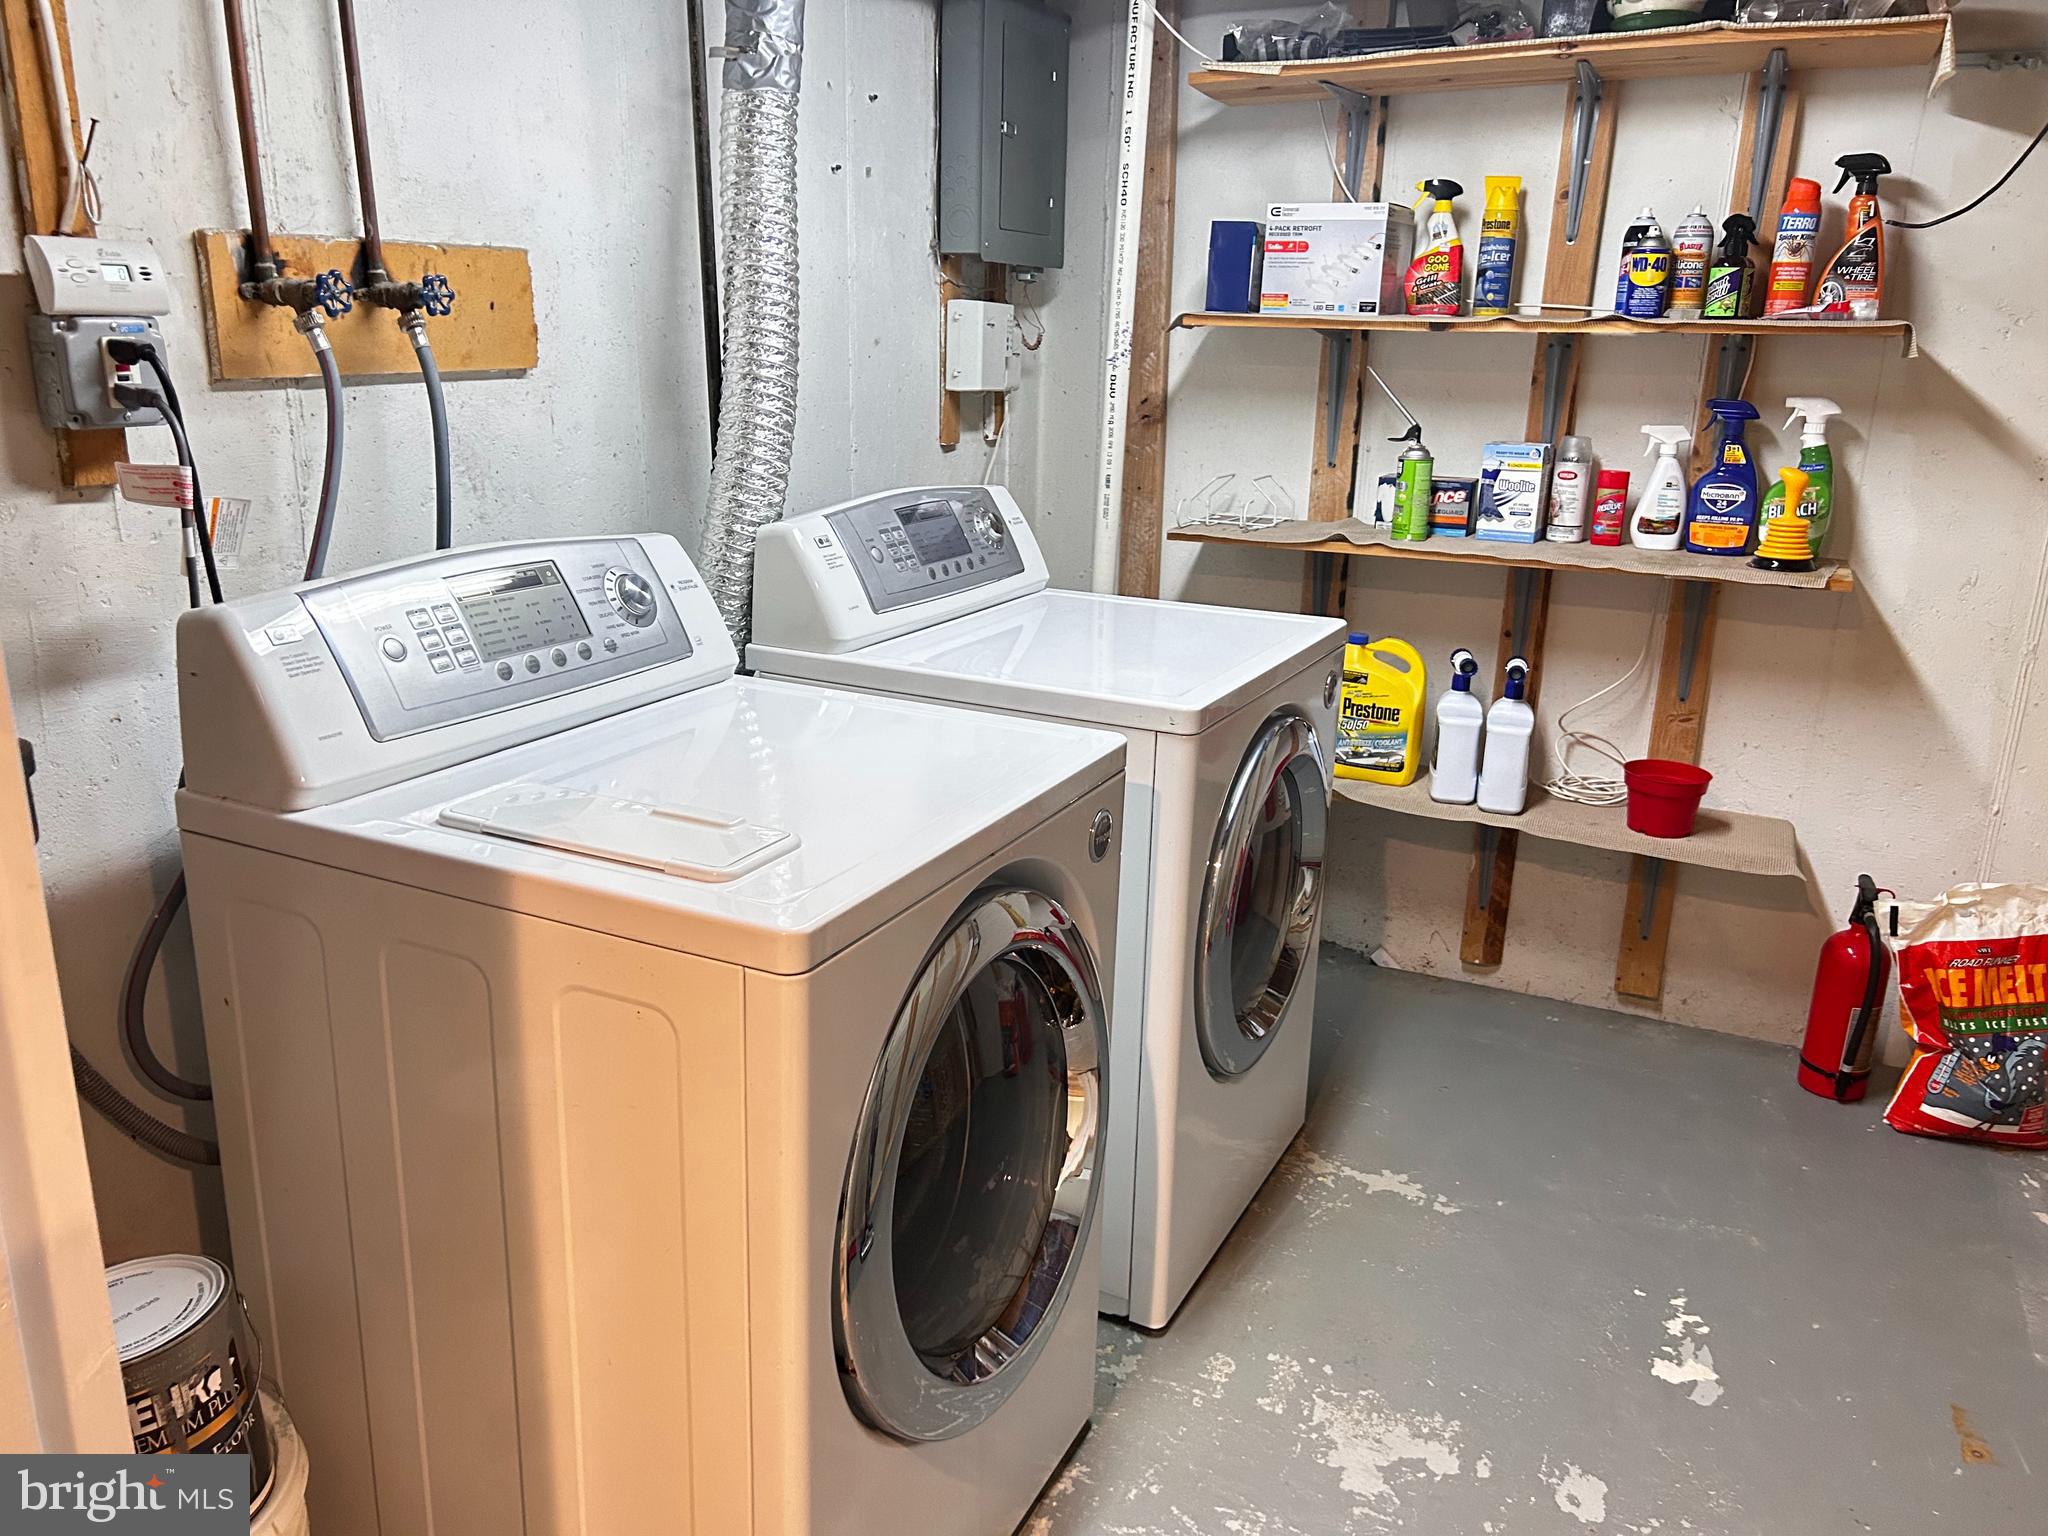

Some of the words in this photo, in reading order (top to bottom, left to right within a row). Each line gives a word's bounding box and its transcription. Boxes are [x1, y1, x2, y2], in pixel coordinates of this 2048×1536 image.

[1127, 0, 1139, 99] NUFACTURING
[1120, 163, 1129, 206] SCH40
[1781, 216, 1817, 230] TERRO
[1778, 233, 1799, 242] Spider
[1428, 255, 1449, 263] GOO
[1424, 263, 1450, 272] GONE
[1837, 266, 1877, 274] WHEEL
[1415, 273, 1438, 286] Grill
[1850, 273, 1875, 281] TIRE
[1419, 280, 1443, 291] Grate
[1498, 478, 1536, 493] Woolite
[1597, 502, 1623, 513] RESOLVE
[374, 624, 393, 633] POWER
[1342, 698, 1400, 722] Prestone
[1339, 719, 1369, 730] 50/50
[1950, 957, 1983, 968] ROAD
[1974, 963, 2047, 1006] MELT
[1985, 1020, 2007, 1029] ICE
[2017, 1017, 2048, 1027] FAST
